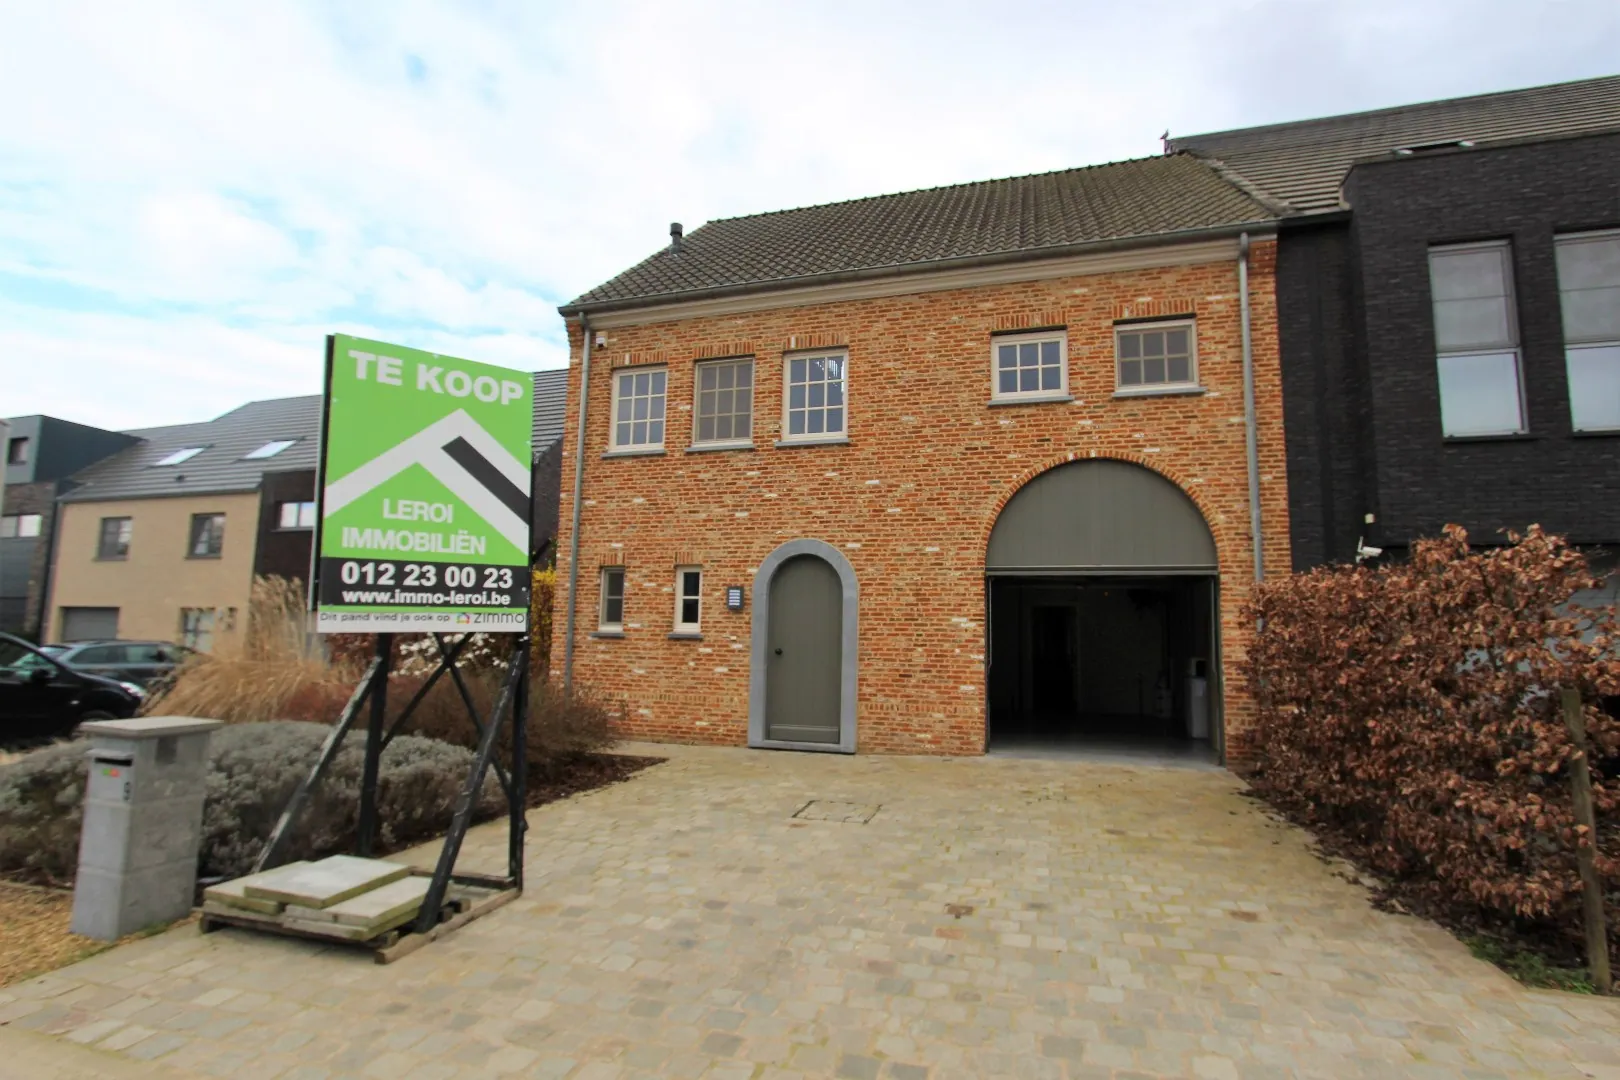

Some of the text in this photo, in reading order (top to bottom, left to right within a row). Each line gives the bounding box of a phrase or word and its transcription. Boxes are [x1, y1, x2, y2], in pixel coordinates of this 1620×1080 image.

[348, 349, 524, 405] TE KOOP
[382, 498, 453, 524] LEROI
[341, 526, 486, 555] IMMOBILIËN
[341, 561, 513, 589] 012 23 00 23
[341, 589, 511, 606] www.immo-leroi.be
[320, 612, 525, 624] Dit pand vind je ook op zimmo
